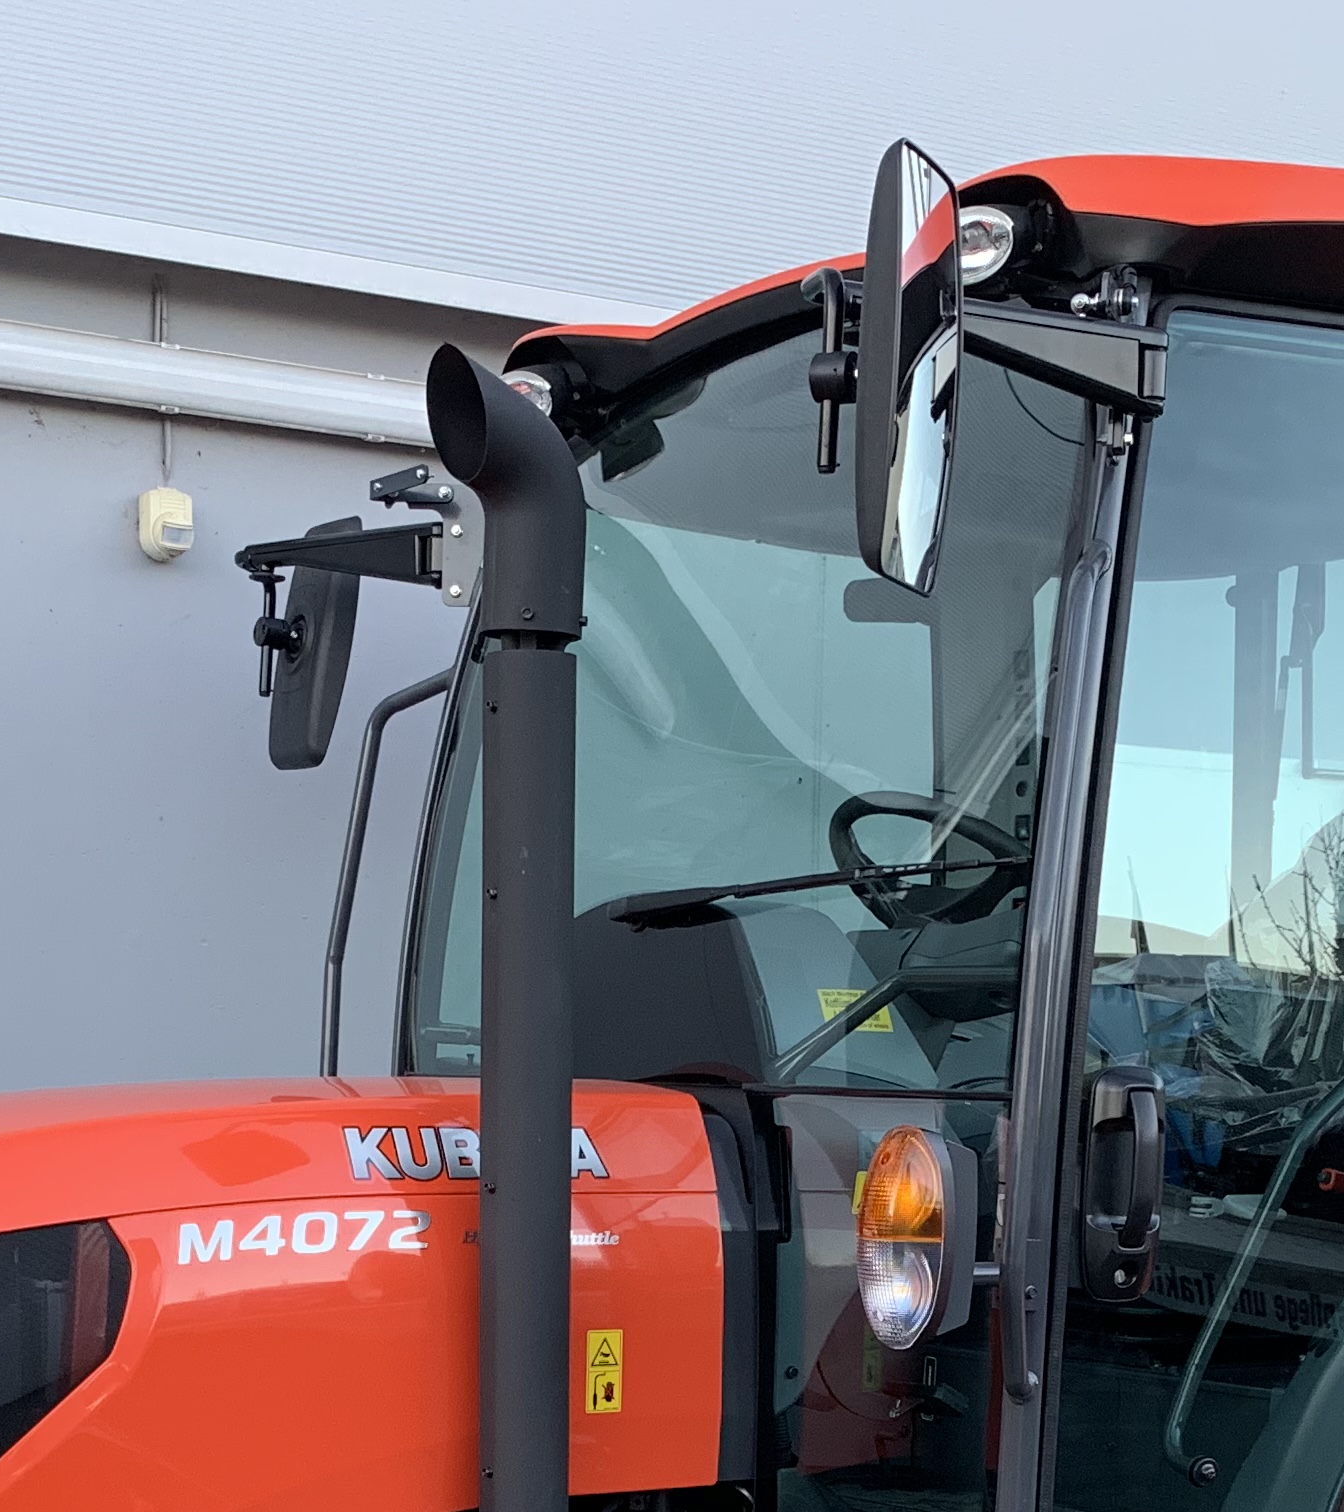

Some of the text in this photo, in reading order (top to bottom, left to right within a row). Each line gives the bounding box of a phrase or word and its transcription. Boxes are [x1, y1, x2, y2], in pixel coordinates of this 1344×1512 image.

[342, 1125, 608, 1181] KUBA
[177, 1210, 432, 1266] M4072
[570, 1230, 620, 1246] huttle
